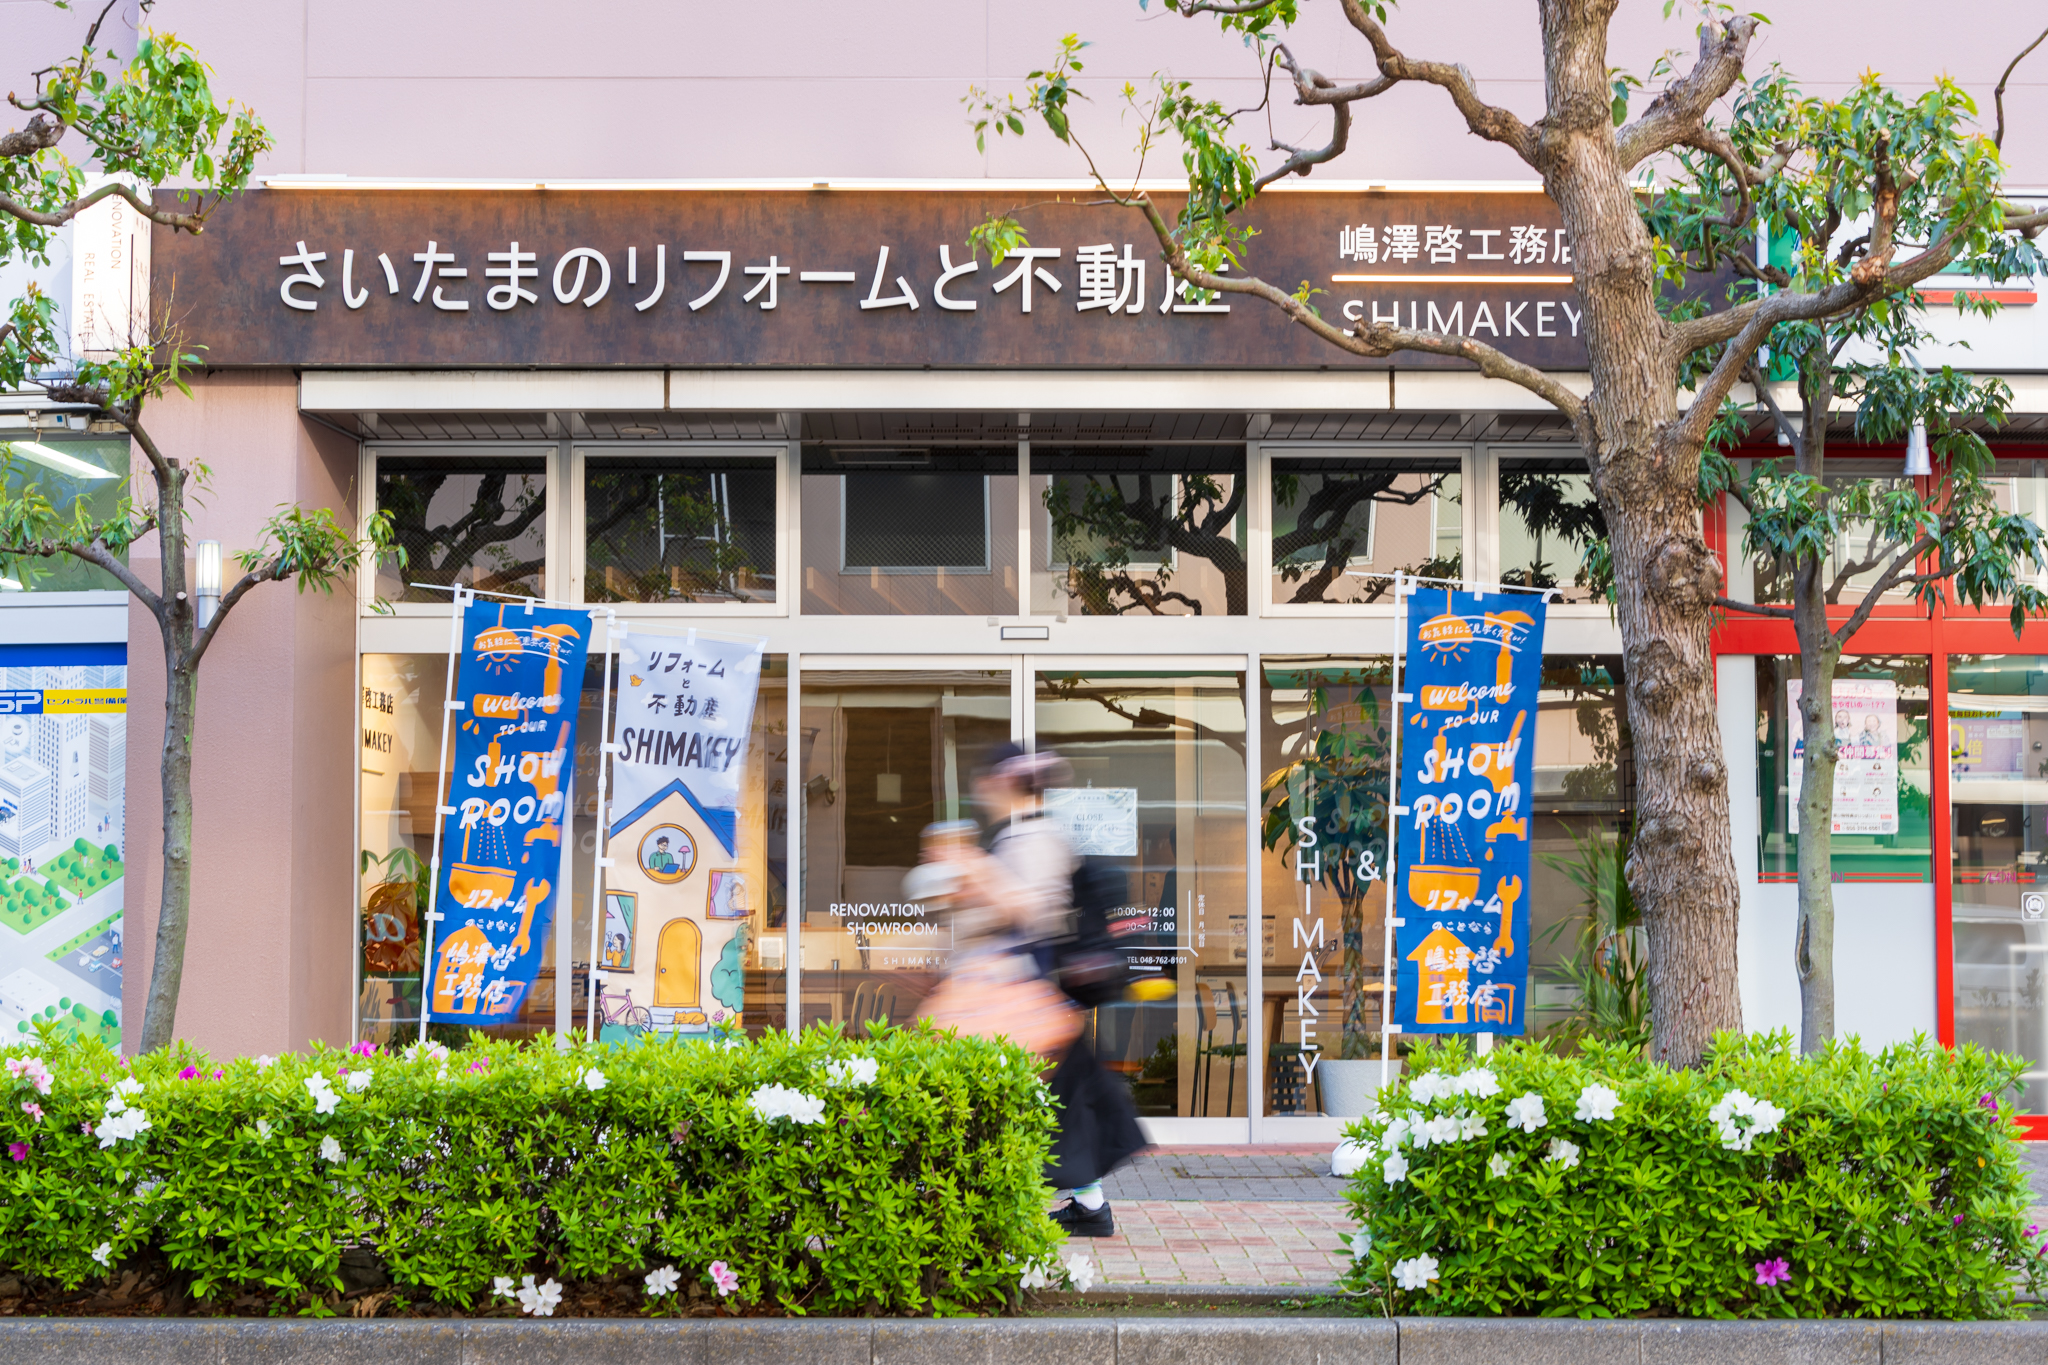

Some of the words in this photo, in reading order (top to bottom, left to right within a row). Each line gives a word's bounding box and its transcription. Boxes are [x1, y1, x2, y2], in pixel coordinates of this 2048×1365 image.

[111, 194, 123, 270] ENOVATION
[84, 252, 95, 283] REAL
[279, 240, 1231, 312] さいたまのリフォームと不動産
[83, 293, 95, 337] ESTATE
[647, 651, 726, 678] リフォーム
[682, 678, 691, 688] と
[1429, 681, 1517, 705] Welcome
[362, 687, 394, 715] 啓工務店
[483, 691, 565, 713] Welcome
[647, 693, 720, 721] 不動産
[499, 724, 516, 735] TO
[520, 719, 547, 733] OUR
[1445, 715, 1463, 729] TO
[1469, 710, 1500, 725] OUR
[618, 727, 741, 772] SHIMAKEY
[1417, 737, 1522, 784] SHOW
[467, 747, 567, 787] SHOW
[459, 791, 565, 829] ROOM
[1076, 813, 1104, 821] CLOSE
[1413, 782, 1521, 830] ROOM
[1357, 850, 1381, 882] &
[463, 889, 527, 913] リフォーム
[829, 903, 925, 917] RENOVATION
[1425, 889, 1502, 914] リフォーム
[465, 918, 517, 934] のことなら
[846, 922, 938, 936] SHOWROOM
[1432, 921, 1492, 935] のことなら
[883, 957, 949, 965] SHIMAKEY
[1127, 956, 1139, 964] TEL
[1293, 816, 1324, 1084] SHIMAKEY
[438, 973, 510, 1003] 工務店
[1424, 979, 1500, 1007] 工務店
